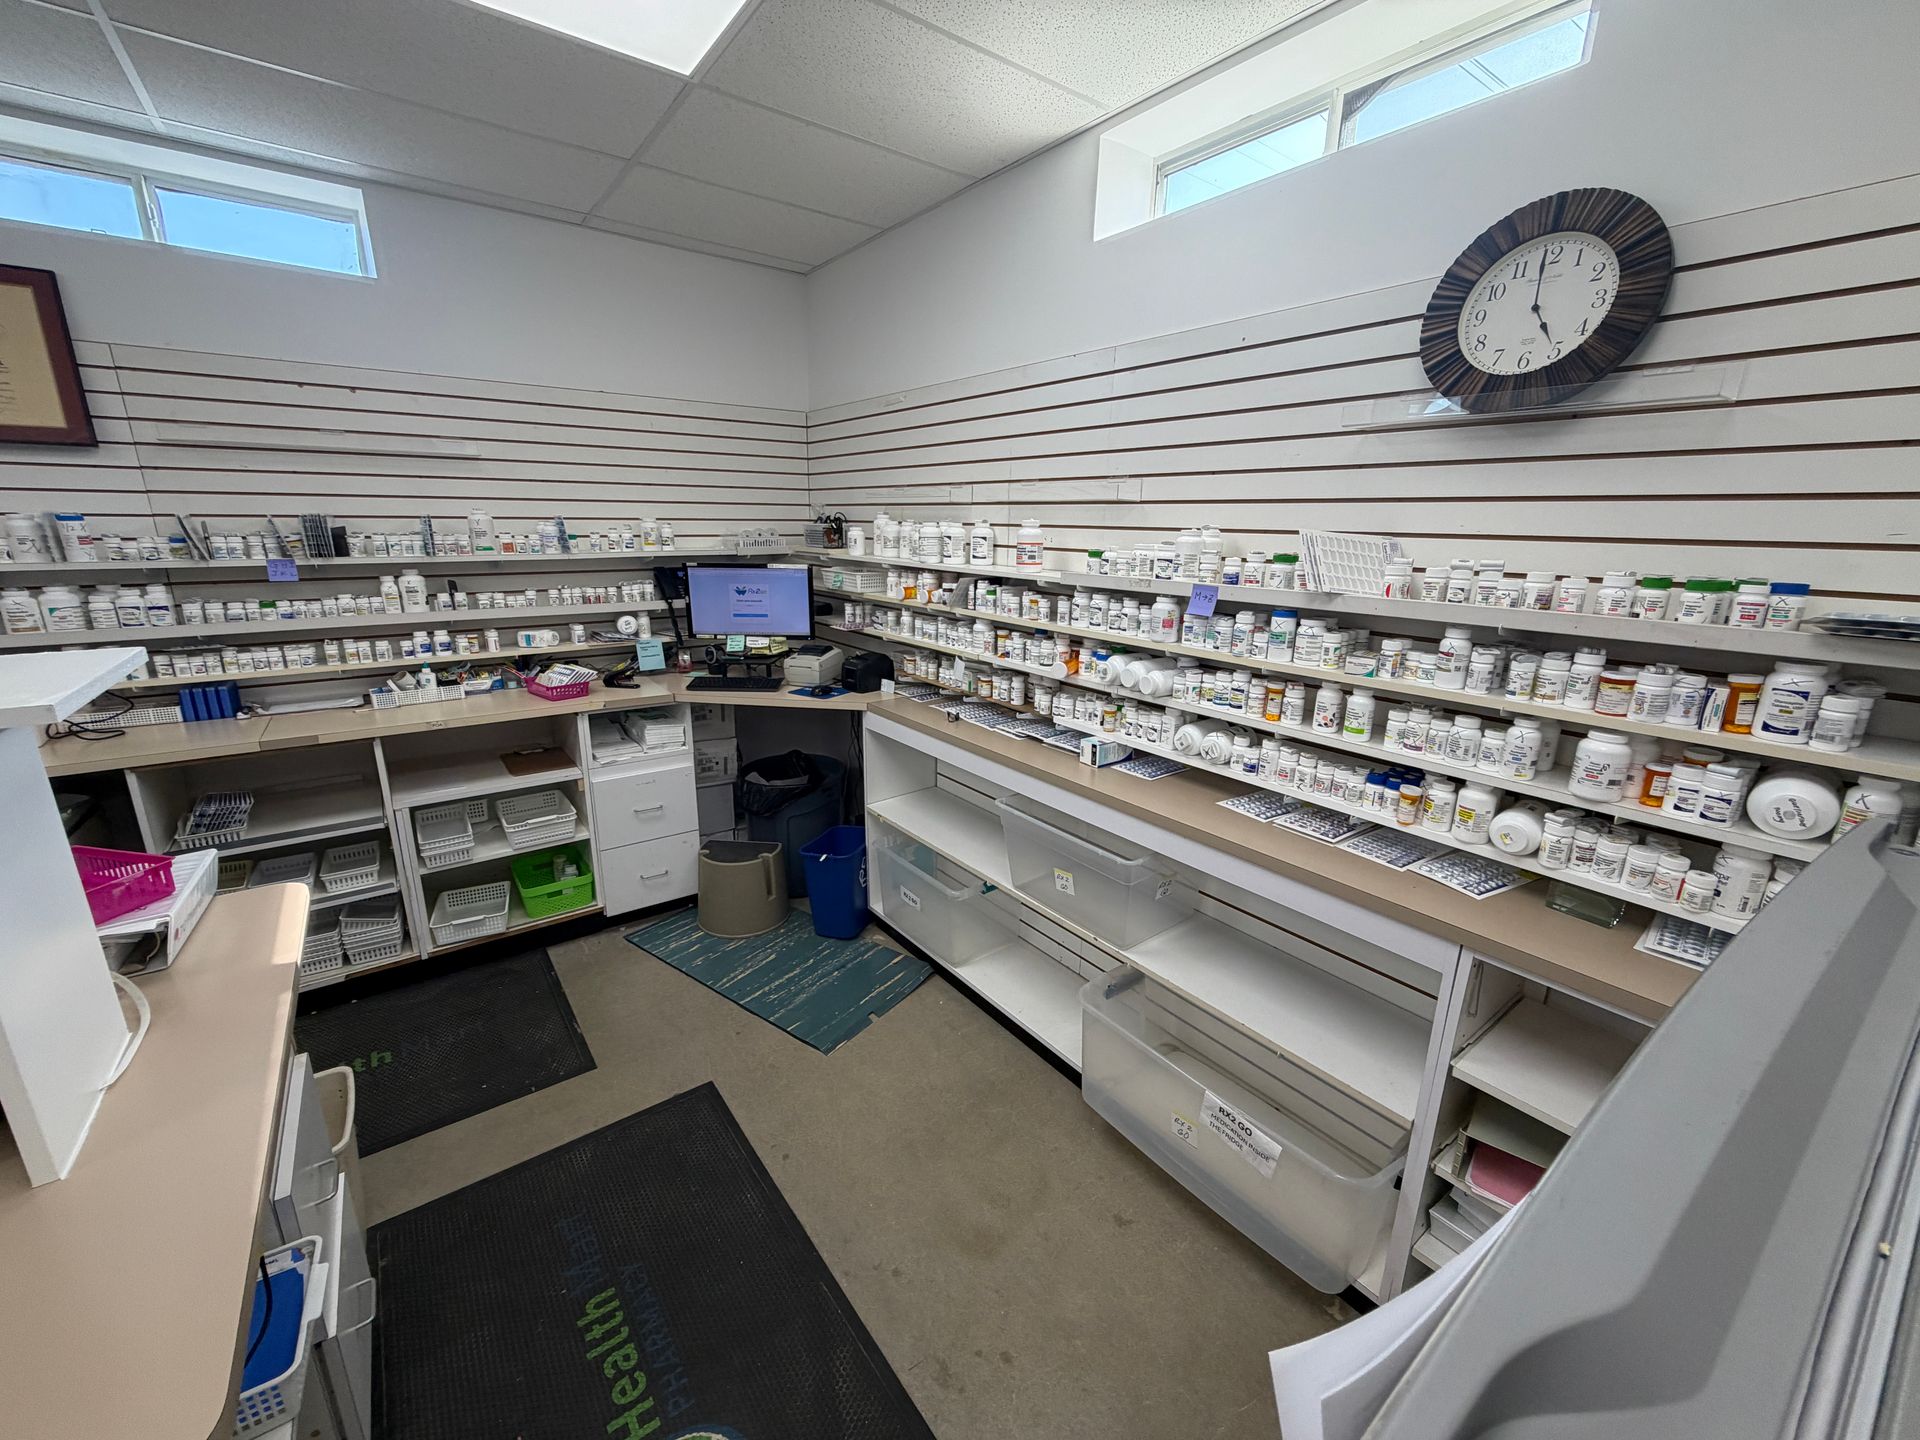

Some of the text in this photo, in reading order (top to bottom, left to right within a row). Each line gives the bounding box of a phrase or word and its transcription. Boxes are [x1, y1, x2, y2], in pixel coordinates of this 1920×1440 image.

[1573, 248, 1584, 267] 1
[1511, 260, 1529, 280] 11
[1589, 262, 1606, 282] 2
[1486, 282, 1506, 302] 10
[1591, 288, 1608, 308] 3
[1473, 309, 1487, 328] 9
[1574, 317, 1589, 336] 4
[1474, 334, 1487, 352] 8
[1547, 341, 1564, 360] 5
[1492, 349, 1505, 367] 7
[1517, 351, 1531, 370] 6
[1218, 1106, 1253, 1137] RX2 GO
[1208, 1121, 1244, 1152] THE FRIDGE
[1210, 1112, 1271, 1163] MEDICATION INSIDE
[576, 1287, 662, 1440] Health
